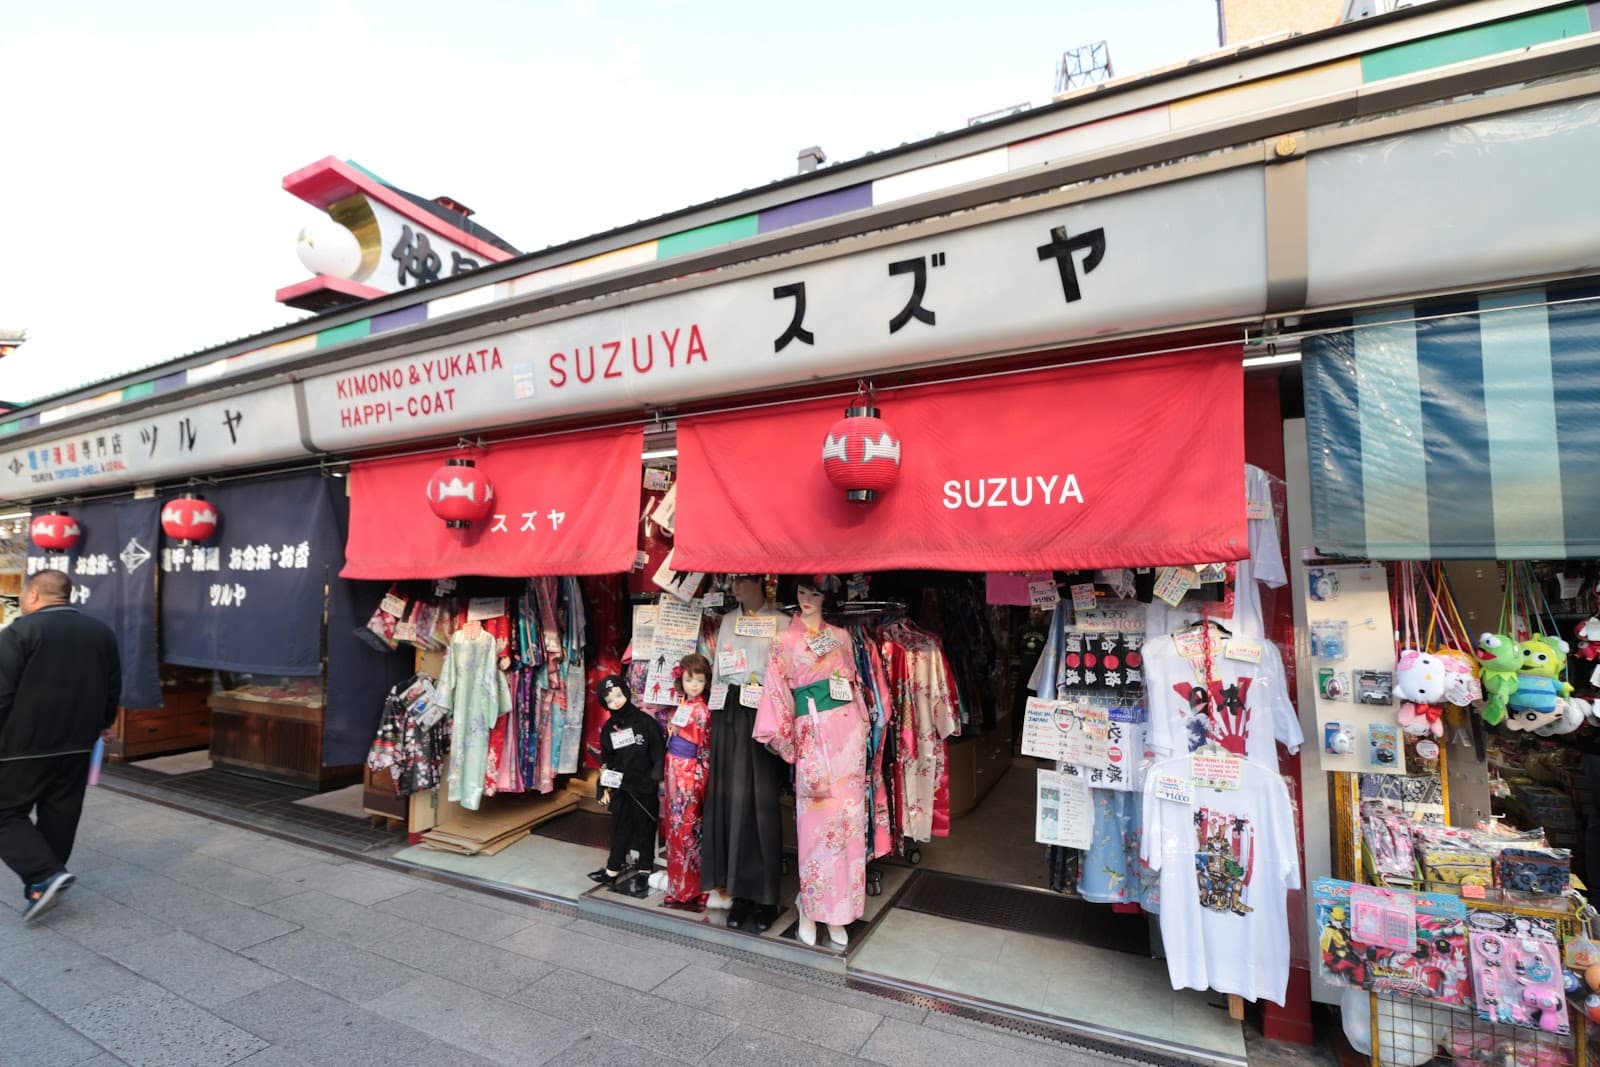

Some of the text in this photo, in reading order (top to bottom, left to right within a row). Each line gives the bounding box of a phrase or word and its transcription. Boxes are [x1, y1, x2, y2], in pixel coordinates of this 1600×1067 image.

[773, 225, 1106, 353] スズヤ
[336, 368, 404, 400] KIMONO
[422, 347, 502, 383] YUKATA
[549, 324, 708, 388] SUZUYA
[340, 388, 456, 429] HAPPI-COAT
[140, 409, 243, 457] ツルヤ
[943, 473, 1085, 509] SUZUYA
[490, 508, 566, 533] スズヤ
[210, 583, 247, 607] ツルヤ
